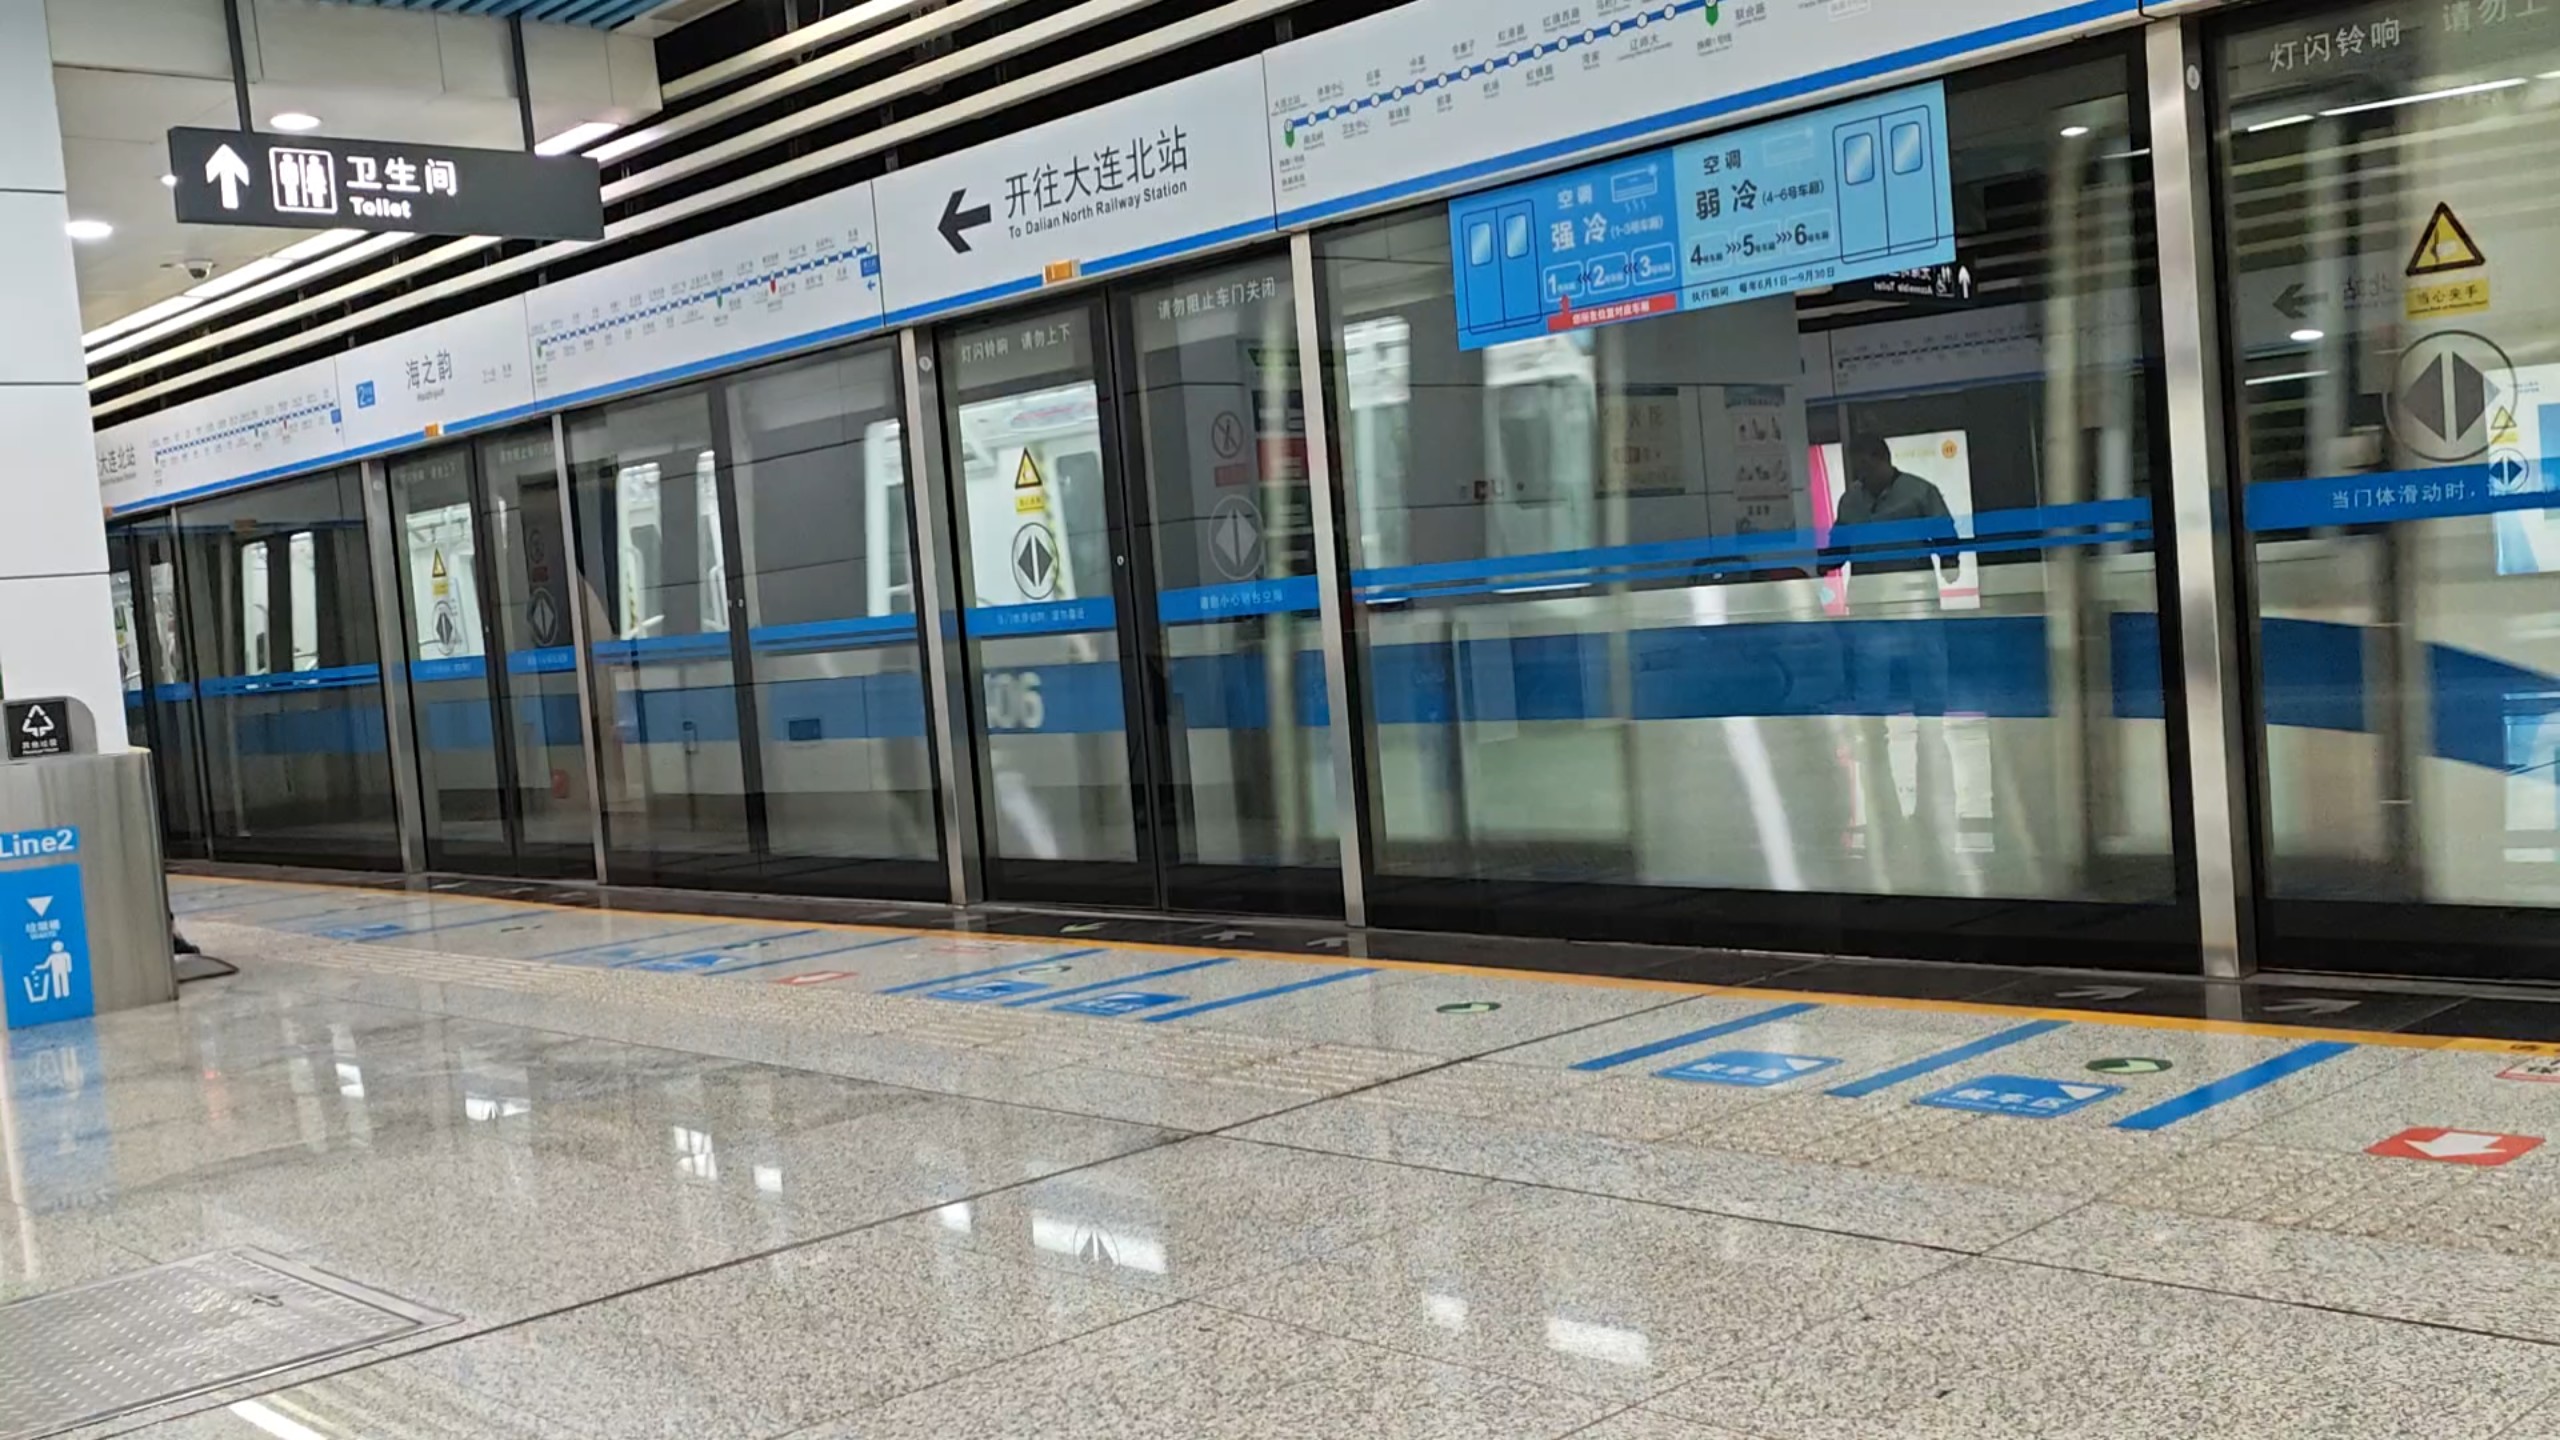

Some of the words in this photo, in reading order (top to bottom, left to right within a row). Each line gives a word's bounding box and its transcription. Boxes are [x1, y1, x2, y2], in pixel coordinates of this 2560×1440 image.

[2270, 18, 2400, 72] 灯闪铃响
[346, 156, 457, 197] 卫生间
[1004, 124, 1188, 219] 开往大连北站
[1703, 149, 1741, 176] 空调
[350, 197, 411, 218] Toilet
[1009, 225, 1021, 239] To
[1026, 216, 1060, 235] Dalian
[1062, 206, 1094, 226] North
[1096, 193, 1140, 216] Railway
[1143, 180, 1187, 203] Station
[1695, 179, 1757, 220] 弱冷
[1551, 212, 1607, 252] 强冷
[1158, 276, 1276, 320] 请勿阻止车门关闭
[1021, 322, 1071, 352] 请勿上下
[406, 349, 453, 390] 海之韵
[0, 829, 75, 858] Line2
